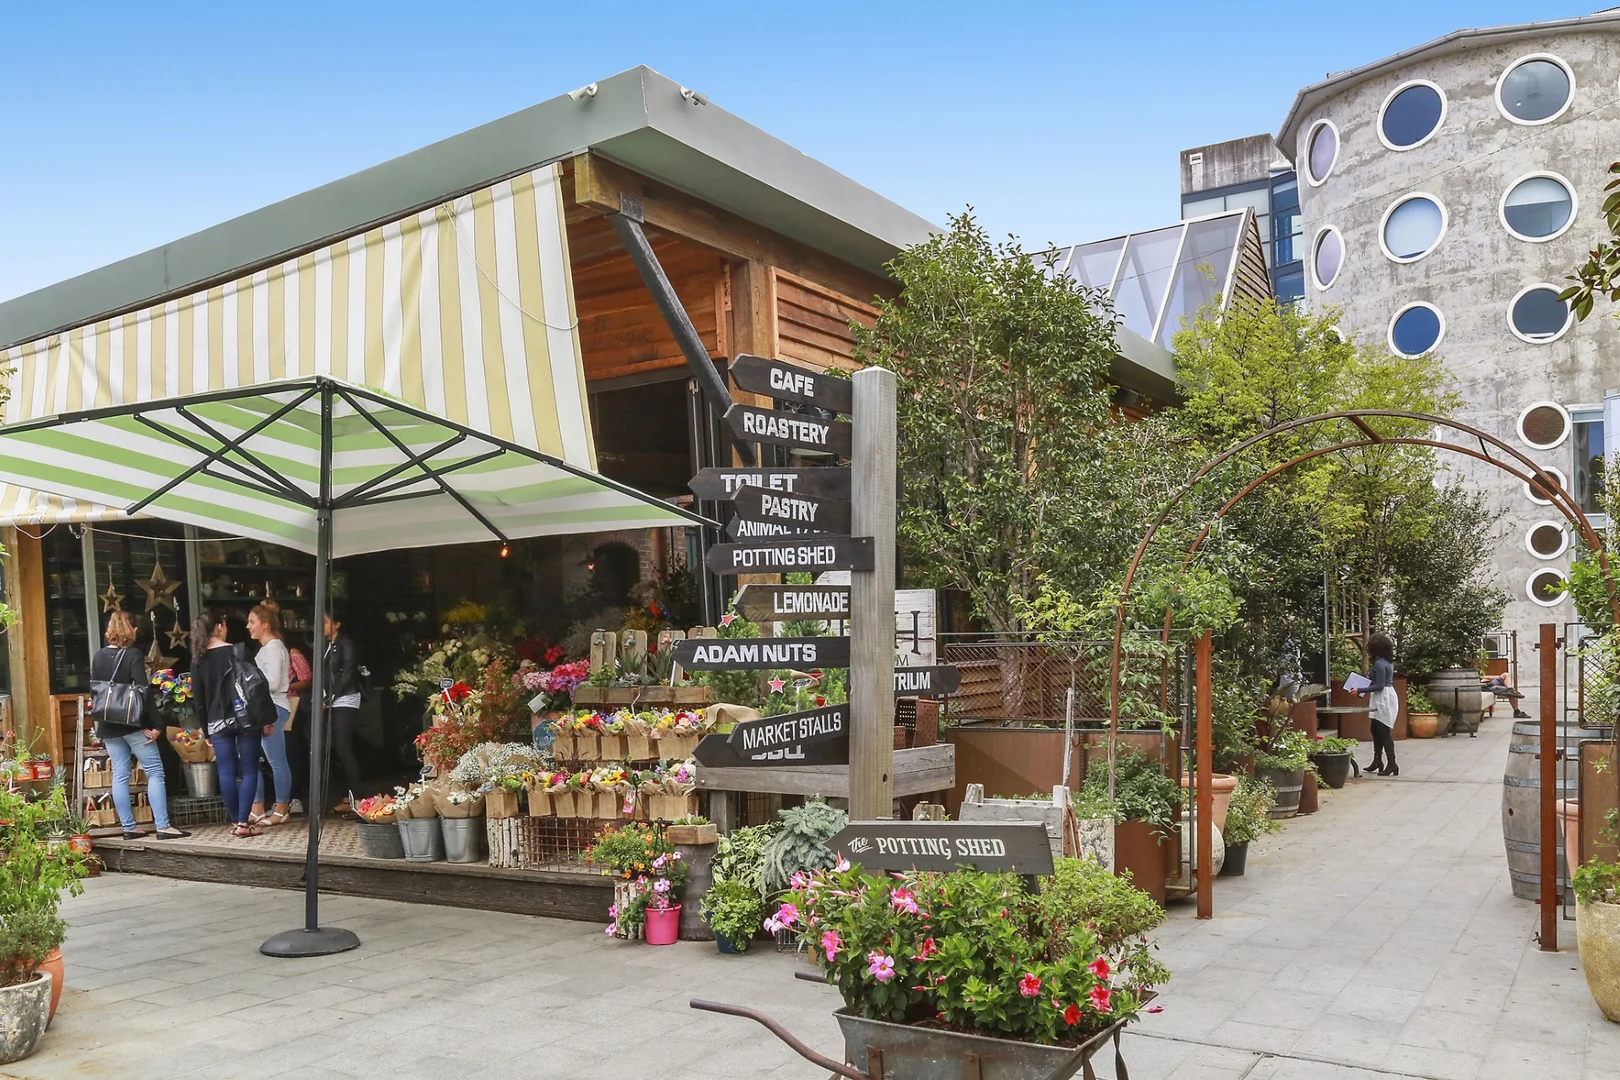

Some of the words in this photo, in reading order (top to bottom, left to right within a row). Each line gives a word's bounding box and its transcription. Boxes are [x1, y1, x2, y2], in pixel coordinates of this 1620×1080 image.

[769, 367, 814, 398] CAFE
[743, 411, 830, 445] ROASTERY
[761, 494, 819, 523] PASTRY
[732, 547, 796, 568] POTTING
[797, 545, 836, 566] SHED
[773, 591, 849, 614] LEMONADE
[692, 644, 760, 664] ADAM
[762, 643, 817, 663] NUTS
[893, 671, 931, 691] TRIUM
[742, 720, 798, 751] MARKET
[799, 711, 842, 740] STALLS
[875, 837, 950, 861] POTTING
[955, 838, 1006, 857] SHED
